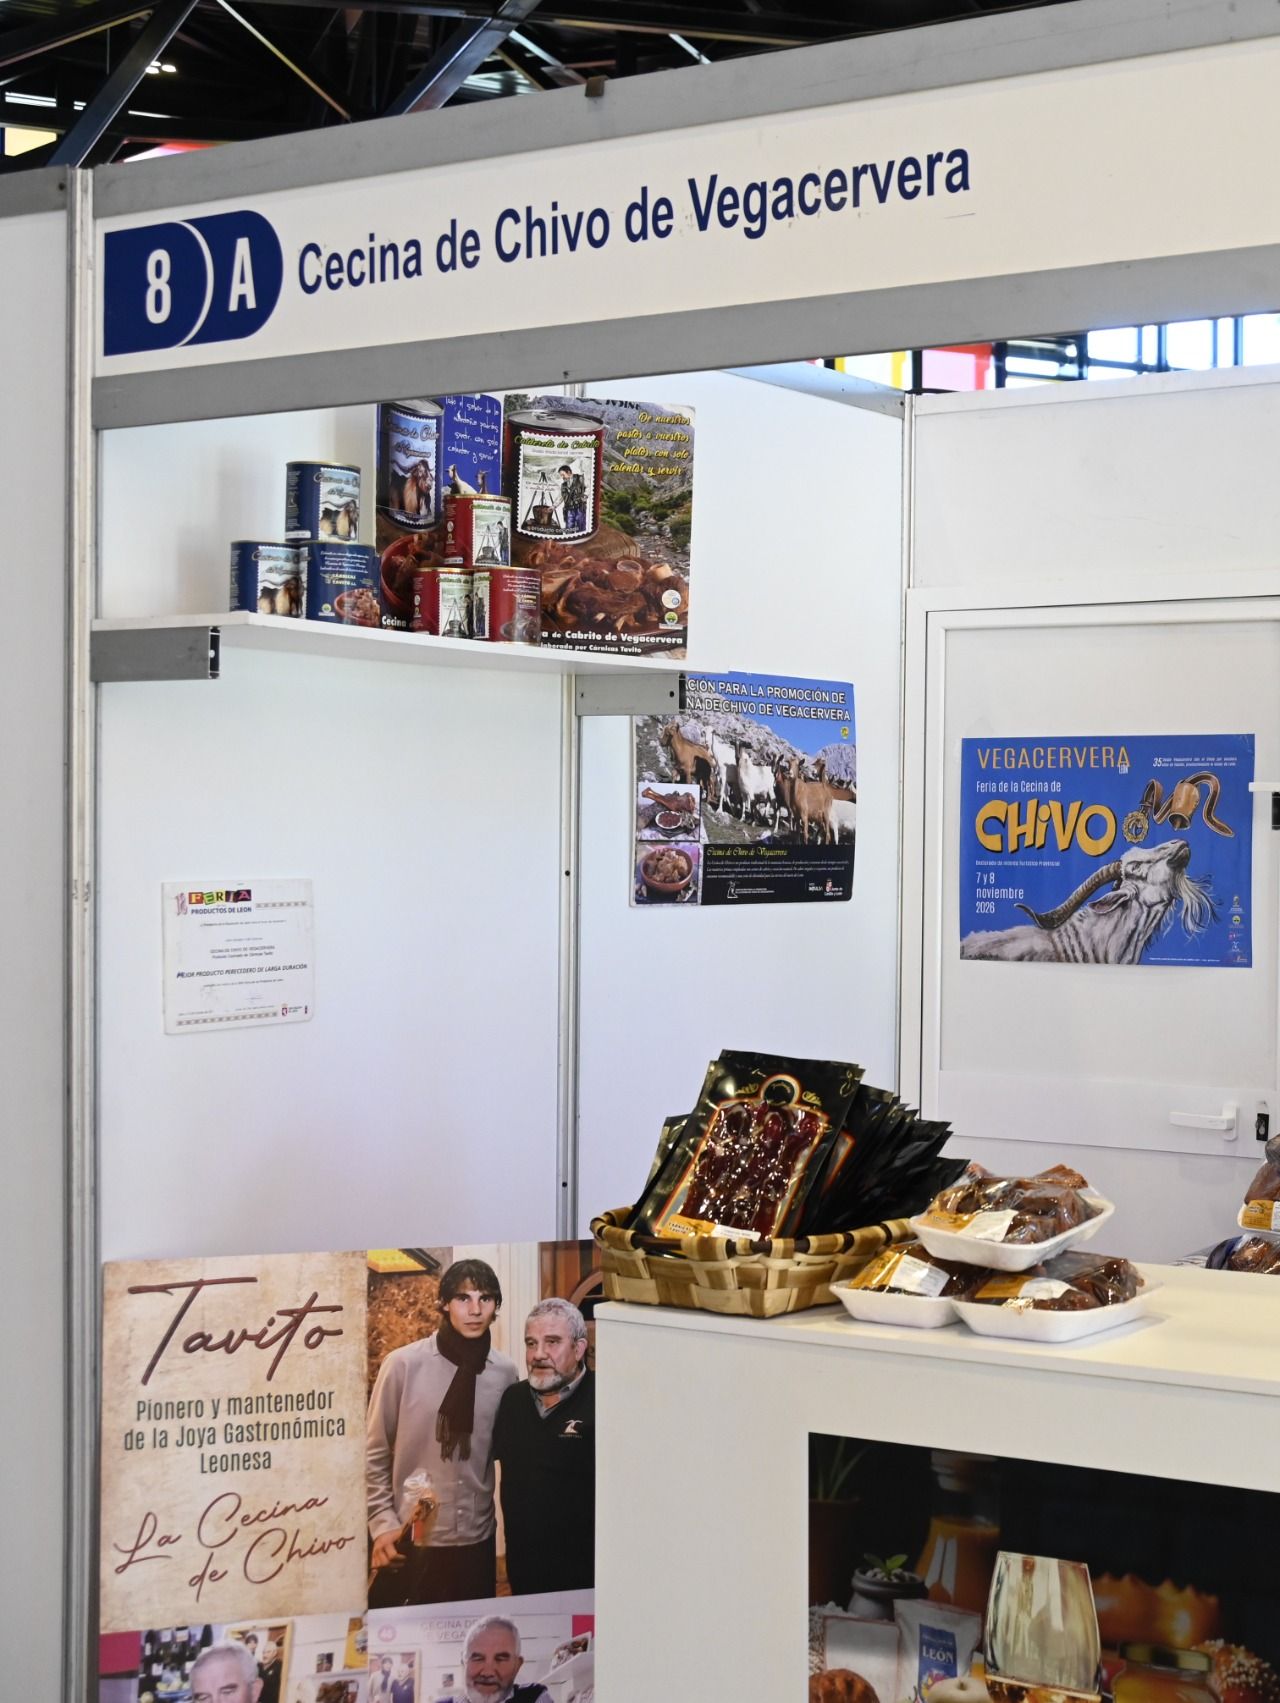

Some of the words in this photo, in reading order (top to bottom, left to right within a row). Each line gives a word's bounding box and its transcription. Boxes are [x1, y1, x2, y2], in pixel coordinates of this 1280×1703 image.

[298, 233, 423, 295] Cecina
[435, 213, 481, 273] de
[494, 202, 611, 264] Chivo
[625, 186, 674, 243] de
[687, 147, 971, 240] Vegacervera
[228, 236, 257, 312] A
[145, 248, 172, 325] 8
[381, 614, 407, 627] Cecina
[551, 631, 562, 639] de
[564, 630, 603, 641] Cabrito
[604, 632, 618, 641] de
[620, 632, 684, 644] Vegacervera
[574, 643, 587, 652] por
[620, 645, 642, 654] Tavito
[718, 680, 748, 696] PARA
[750, 684, 765, 698] LA
[767, 686, 830, 702] PROMOCIÓN
[831, 692, 846, 704] DE
[705, 699, 721, 712] DE
[722, 700, 756, 715] CHIVO
[759, 703, 775, 716] DE
[775, 704, 851, 722] VEGACERVERA
[976, 745, 1131, 770] VEGACERVERA
[976, 780, 997, 793] Feria
[998, 780, 1008, 793] de
[1010, 780, 1018, 793] la
[1020, 780, 1048, 793] Cecina
[1049, 780, 1062, 793] de
[975, 871, 981, 884] 7
[983, 873, 988, 885] y
[989, 871, 995, 885] 8
[976, 887, 1024, 899] noviembre
[190, 907, 228, 915] PRODUCTOS
[195, 969, 224, 977] PRODUCTO
[265, 965, 282, 973] LARGA
[127, 1276, 344, 1386] Tavito
[136, 1398, 205, 1422] Pionero
[211, 1398, 221, 1419] y
[227, 1389, 335, 1416] mantenedor
[123, 1429, 145, 1451] de
[152, 1427, 169, 1449] la
[174, 1425, 217, 1450] Joya
[223, 1416, 346, 1445] Gastronómica
[200, 1450, 273, 1475] Leonesa
[113, 1512, 182, 1575] La
[197, 1491, 329, 1549] Cecina
[188, 1551, 228, 1603] de
[243, 1527, 355, 1584] Chivo
[922, 1644, 954, 1665] LEÓN
